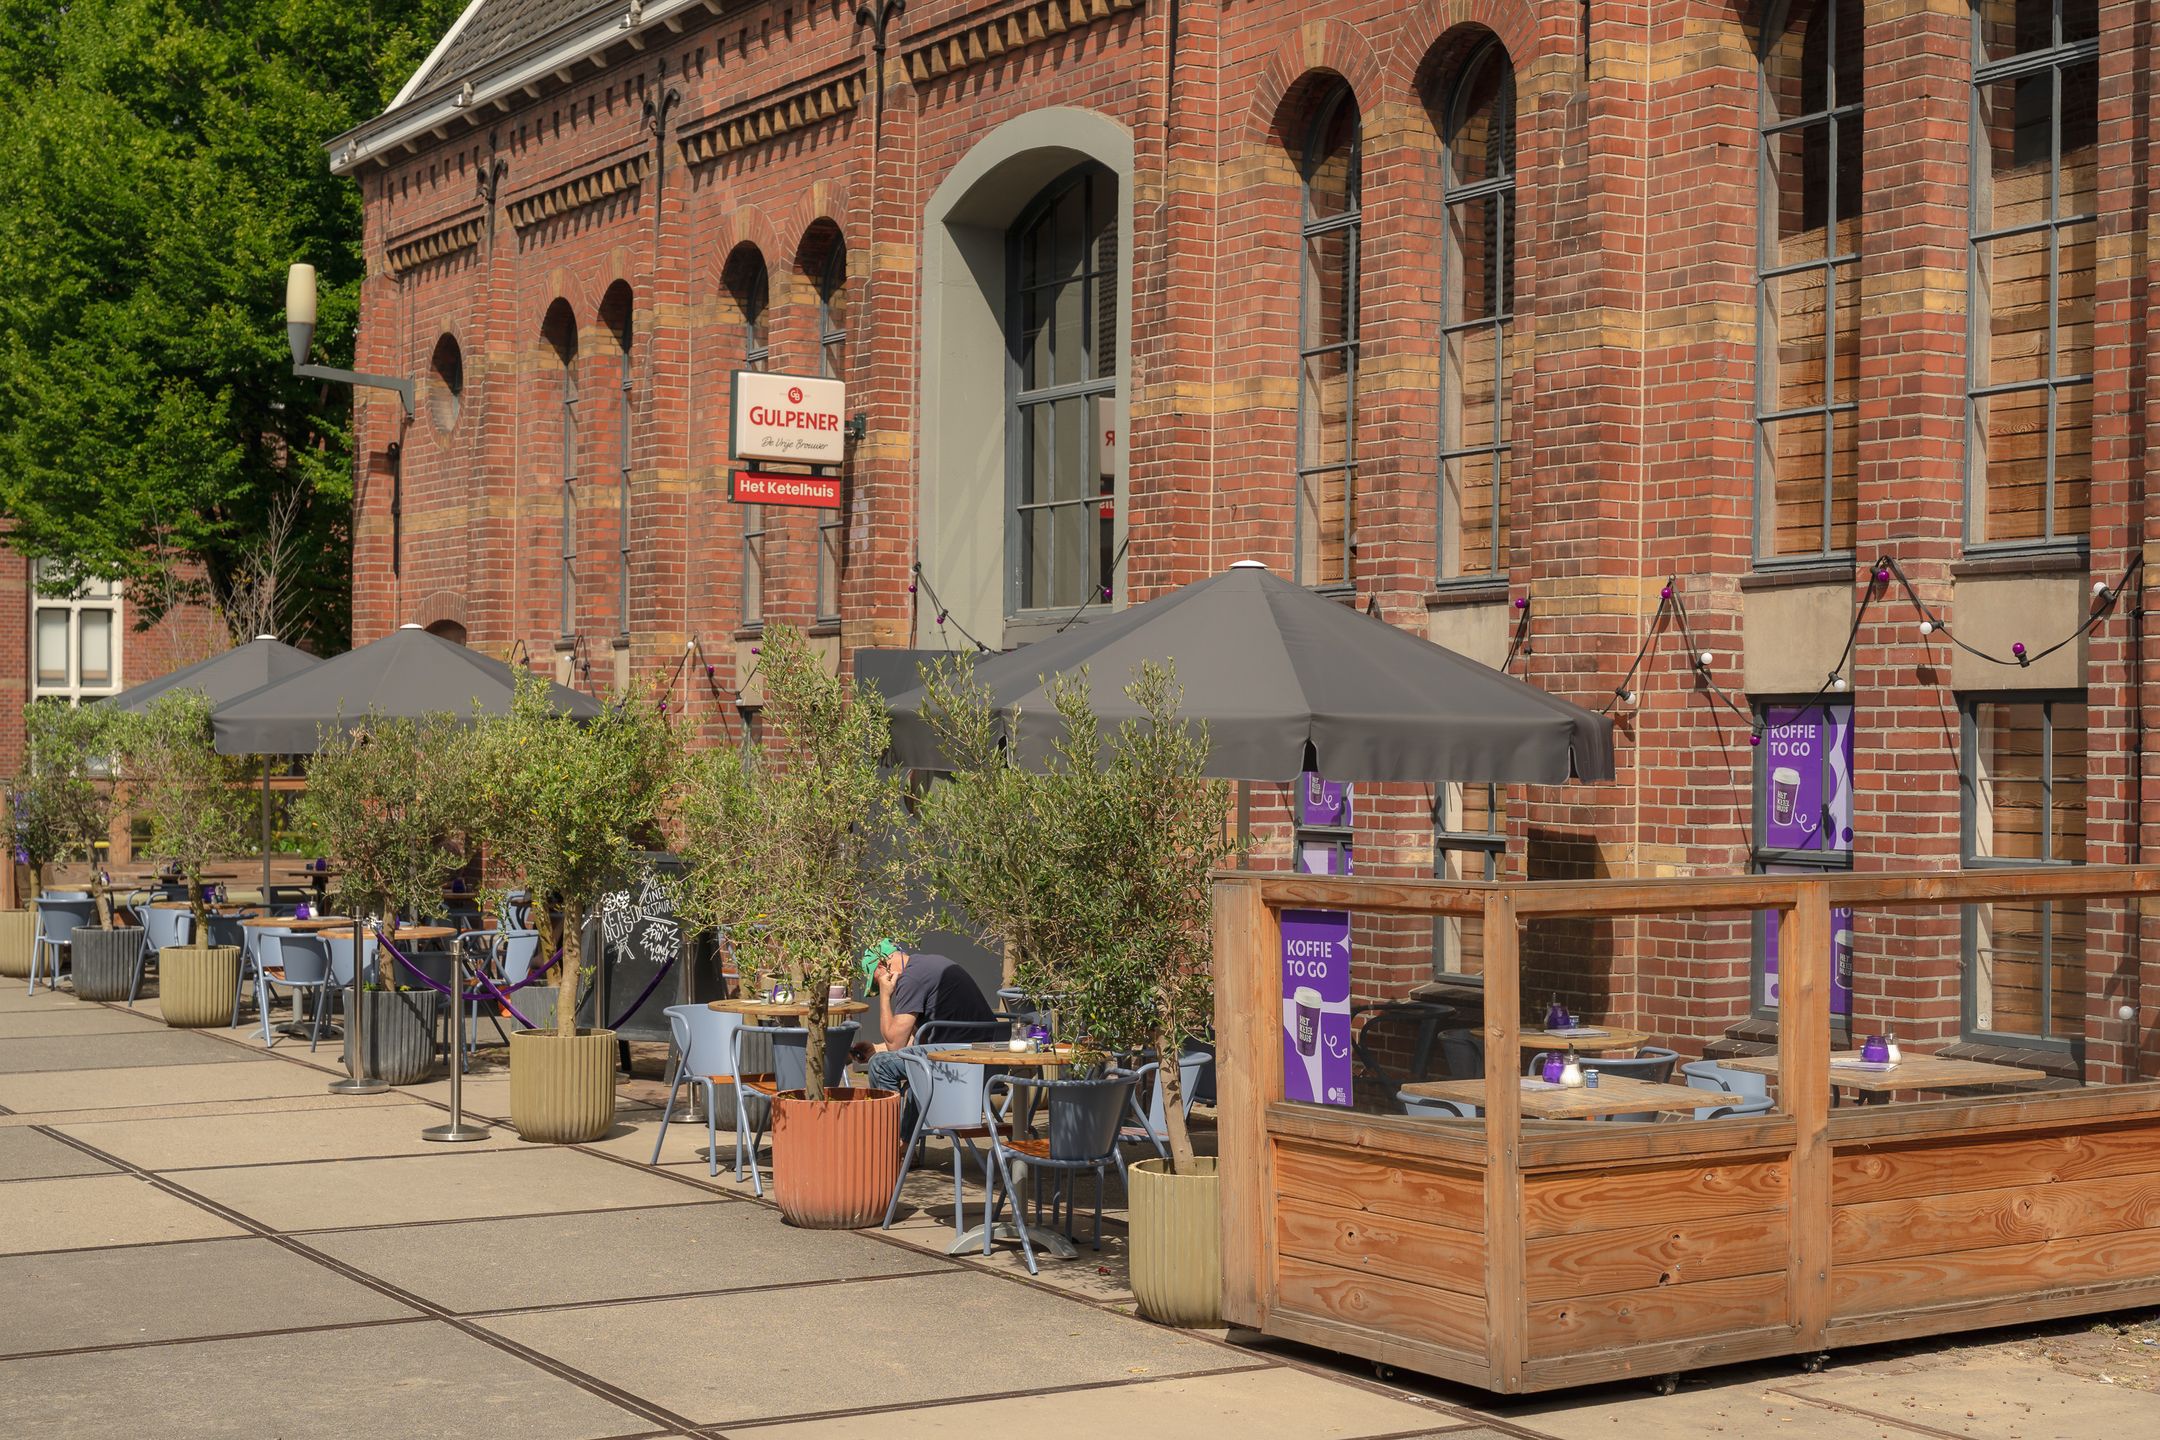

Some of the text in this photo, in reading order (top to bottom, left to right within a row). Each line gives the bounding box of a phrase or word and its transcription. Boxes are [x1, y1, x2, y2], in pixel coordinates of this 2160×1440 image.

[750, 406, 839, 432] GULPENER
[761, 436, 774, 448] De
[795, 439, 829, 450] Brouwer
[740, 480, 834, 498] Het Ketelhuis
[1771, 724, 1816, 739] KOFFIE
[1771, 742, 1811, 756] TO GO
[1287, 939, 1332, 958] KOFFIE
[1287, 960, 1327, 978] TO GO
